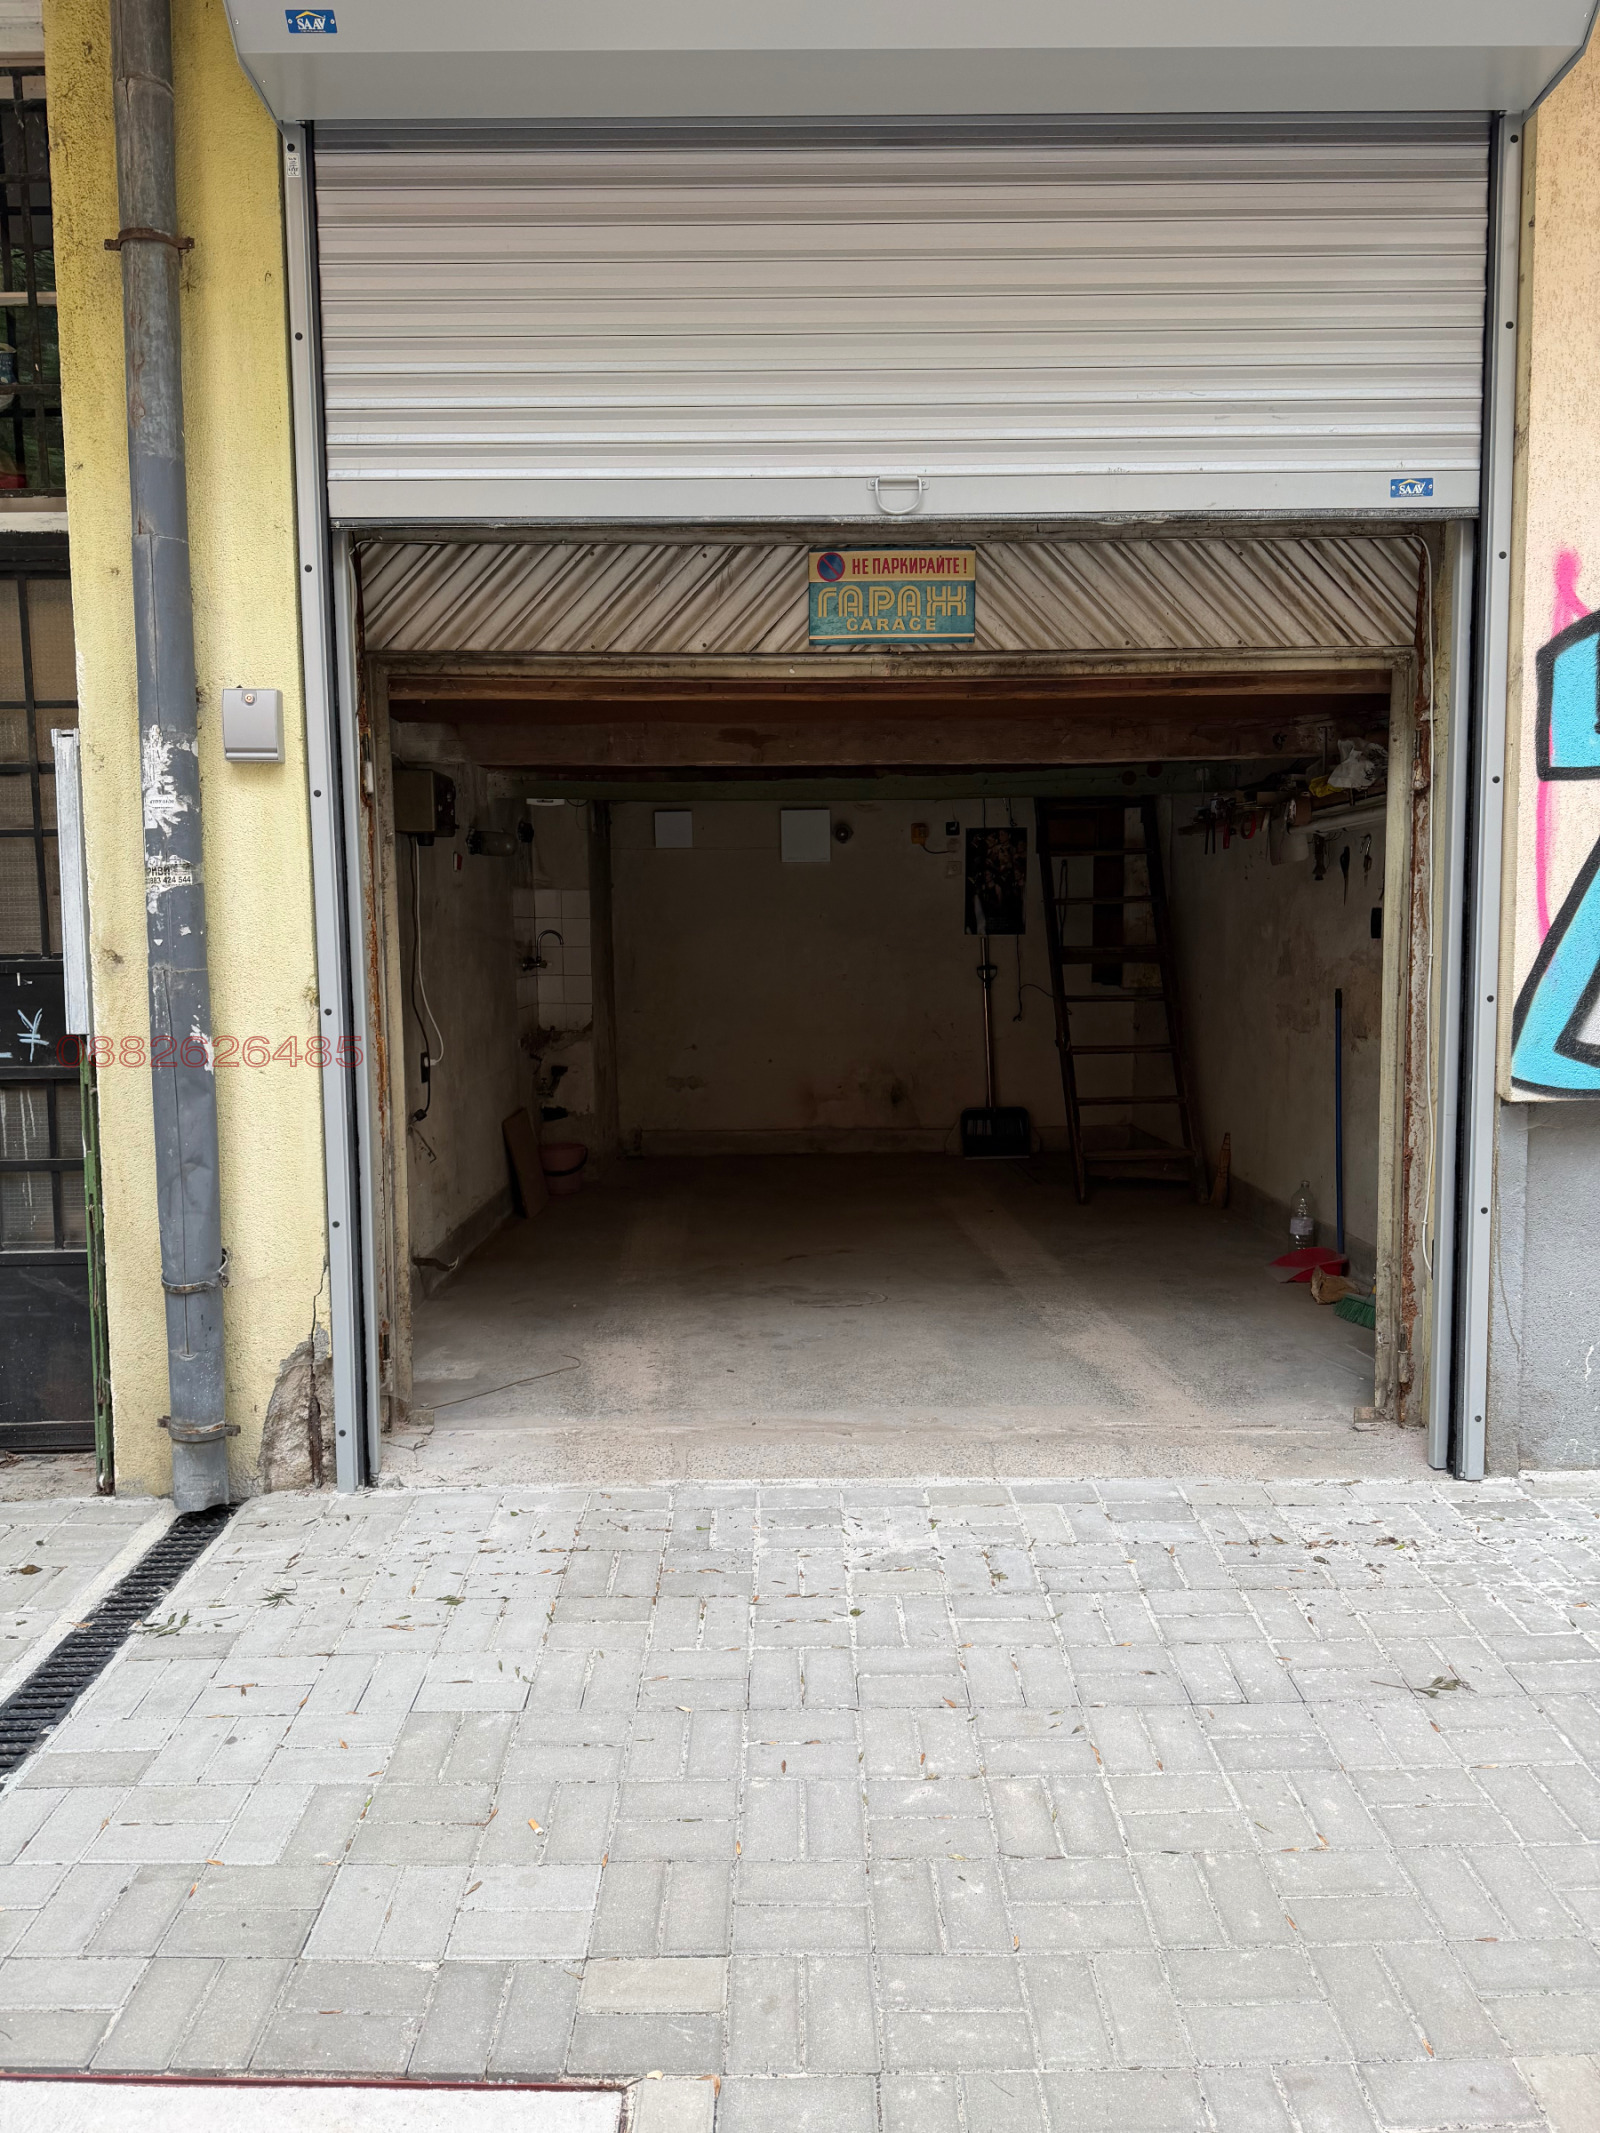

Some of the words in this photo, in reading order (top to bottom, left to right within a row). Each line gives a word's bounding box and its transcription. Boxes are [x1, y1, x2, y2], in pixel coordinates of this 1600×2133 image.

[297, 18, 326, 30] SAAV
[1399, 484, 1425, 494] SAAV
[852, 558, 868, 575] НЕ
[817, 585, 967, 618] ГАРАЖ
[846, 618, 936, 631] GARAGE
